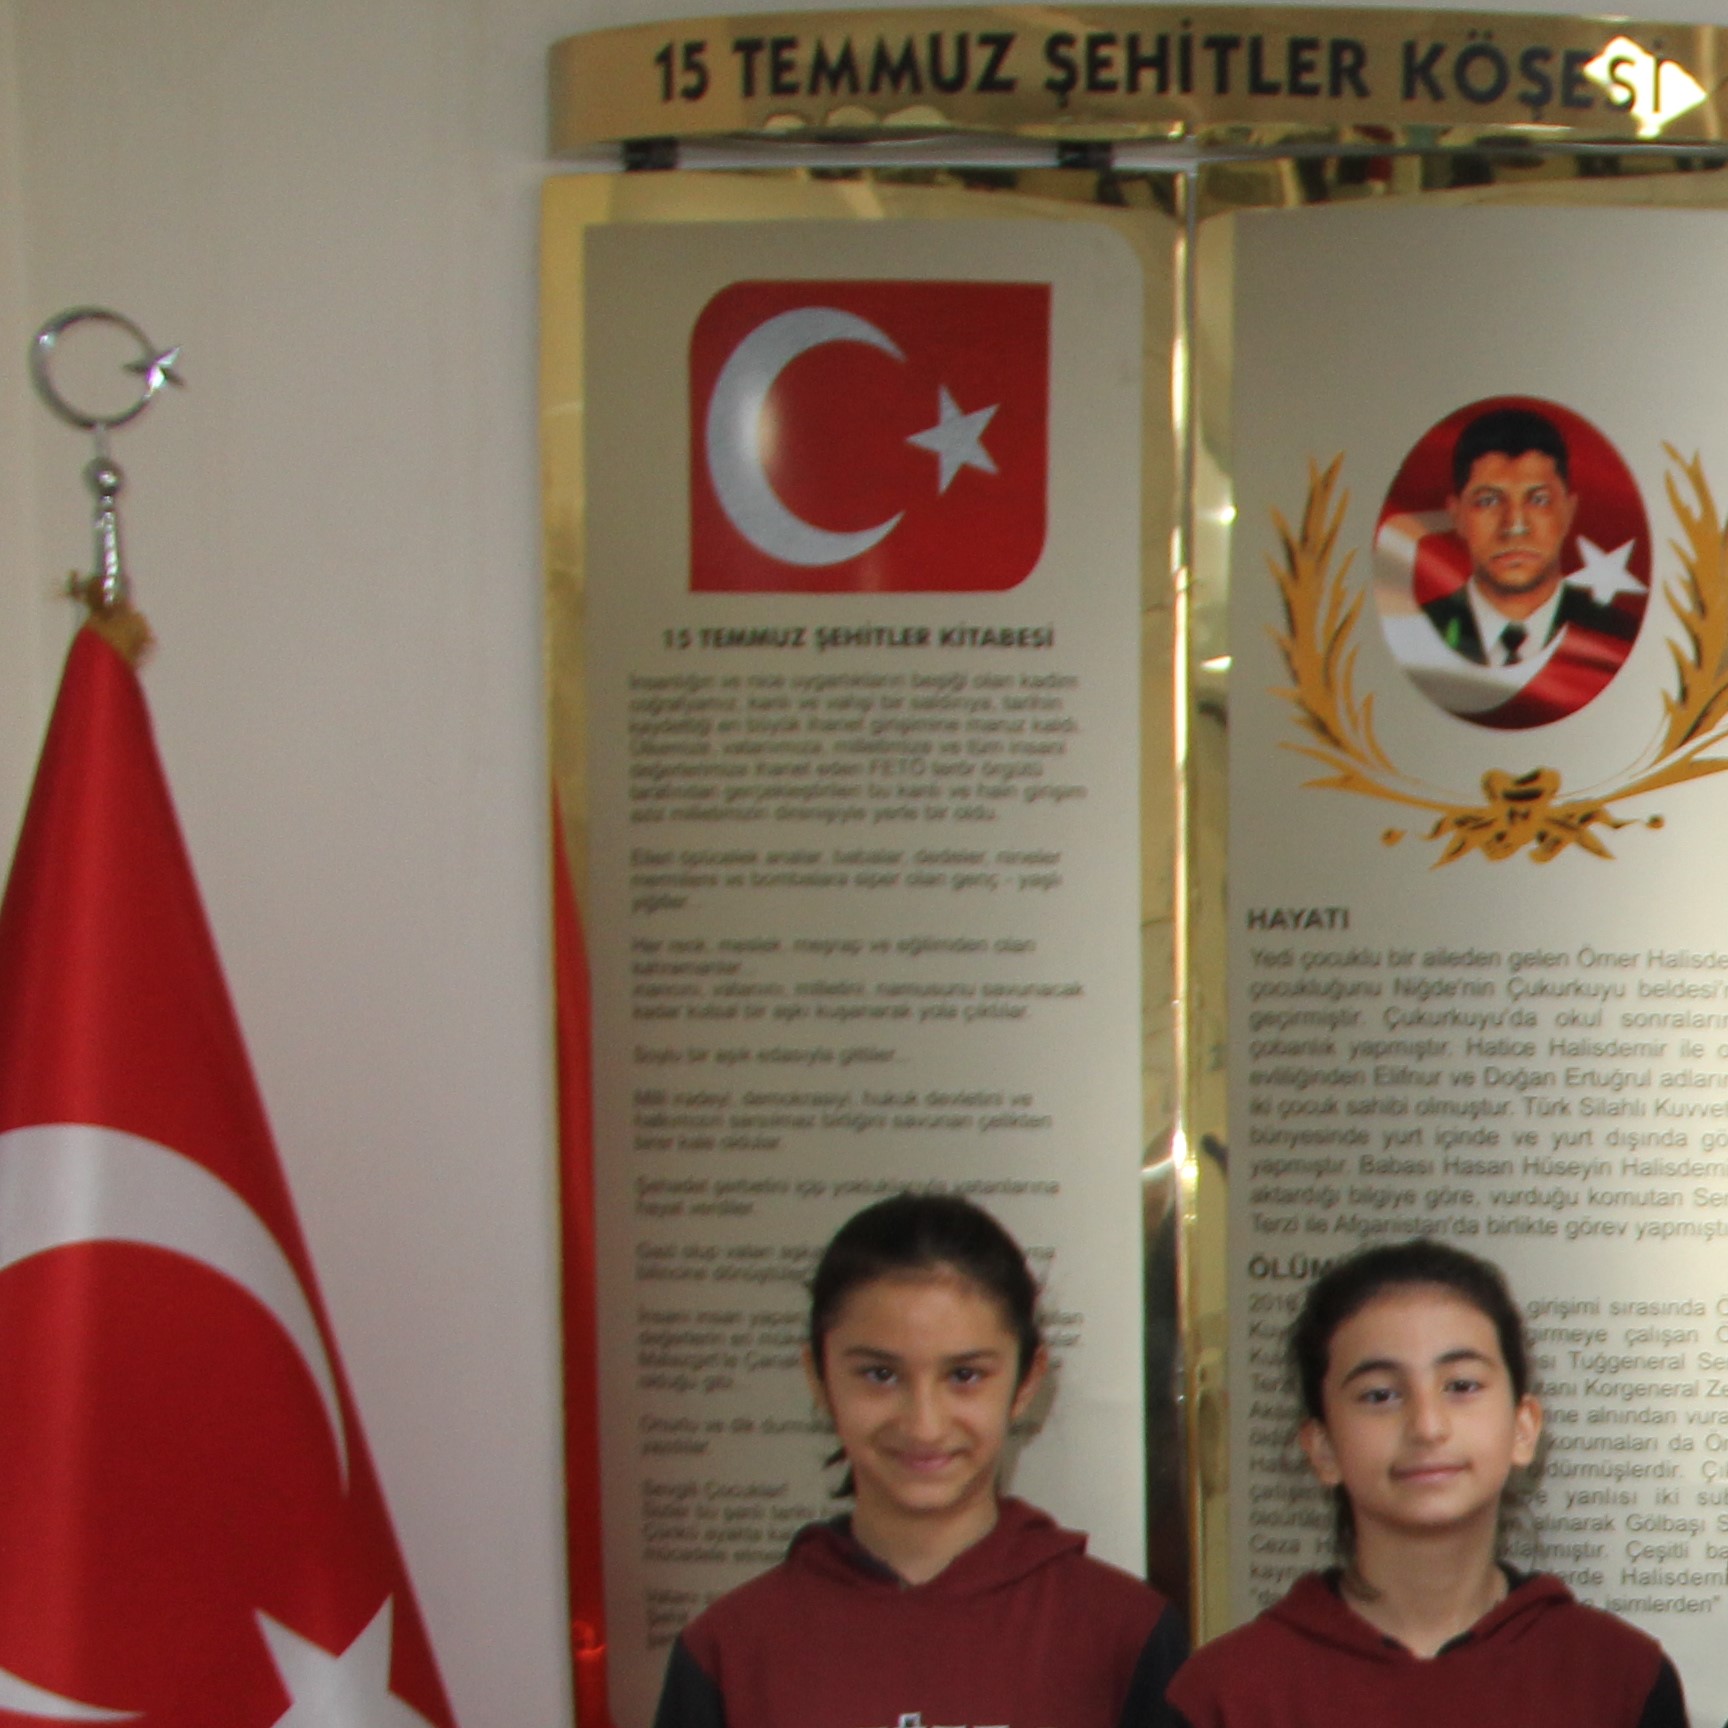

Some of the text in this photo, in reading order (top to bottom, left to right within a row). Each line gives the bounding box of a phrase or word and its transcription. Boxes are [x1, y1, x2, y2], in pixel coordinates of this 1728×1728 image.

[655, 18, 1666, 120] 15 TEMMUZ ŞEHİTLER KÖŞESİ
[663, 621, 1056, 653] 15 TEMMUZ ŞEHİTLER KİTABESİ
[1247, 908, 1349, 930] HAYATI
[1507, 950, 1570, 974] gelen
[1576, 945, 1640, 969] Ömer
[1506, 977, 1626, 1002] Çukurkuyu
[1555, 1009, 1602, 1029] okul
[1548, 1039, 1667, 1059] Halisdemir
[1680, 1040, 1705, 1059] ile
[1483, 1066, 1556, 1093] Doğan
[1564, 1067, 1651, 1093] Ertuğrul
[1523, 1096, 1571, 1118] Türk
[1579, 1097, 1646, 1118] Silahlı
[1513, 1131, 1538, 1147] ve
[1552, 1130, 1593, 1152] yurt
[1605, 1129, 1689, 1152] dışında
[1522, 1157, 1612, 1181] Hüseyin
[1490, 1187, 1579, 1212] vurduğu
[1587, 1189, 1683, 1208] komutan
[1486, 1217, 1558, 1237] birlikte
[1565, 1217, 1628, 1241] görev
[1527, 1295, 1601, 1319] girişimi
[1609, 1297, 1705, 1316] sırasında
[1624, 1326, 1698, 1347] çalışan
[1568, 1349, 1685, 1373] Tuğgeneral
[1583, 1378, 1698, 1401] Korgeneral
[1587, 1406, 1676, 1424] alnından
[1668, 1434, 1693, 1452] da
[1566, 1488, 1637, 1508] yanlısı
[1655, 1488, 1679, 1506] iki
[1626, 1513, 1705, 1537] Gölbaşı
[1625, 1540, 1689, 1563] Çeşitli
